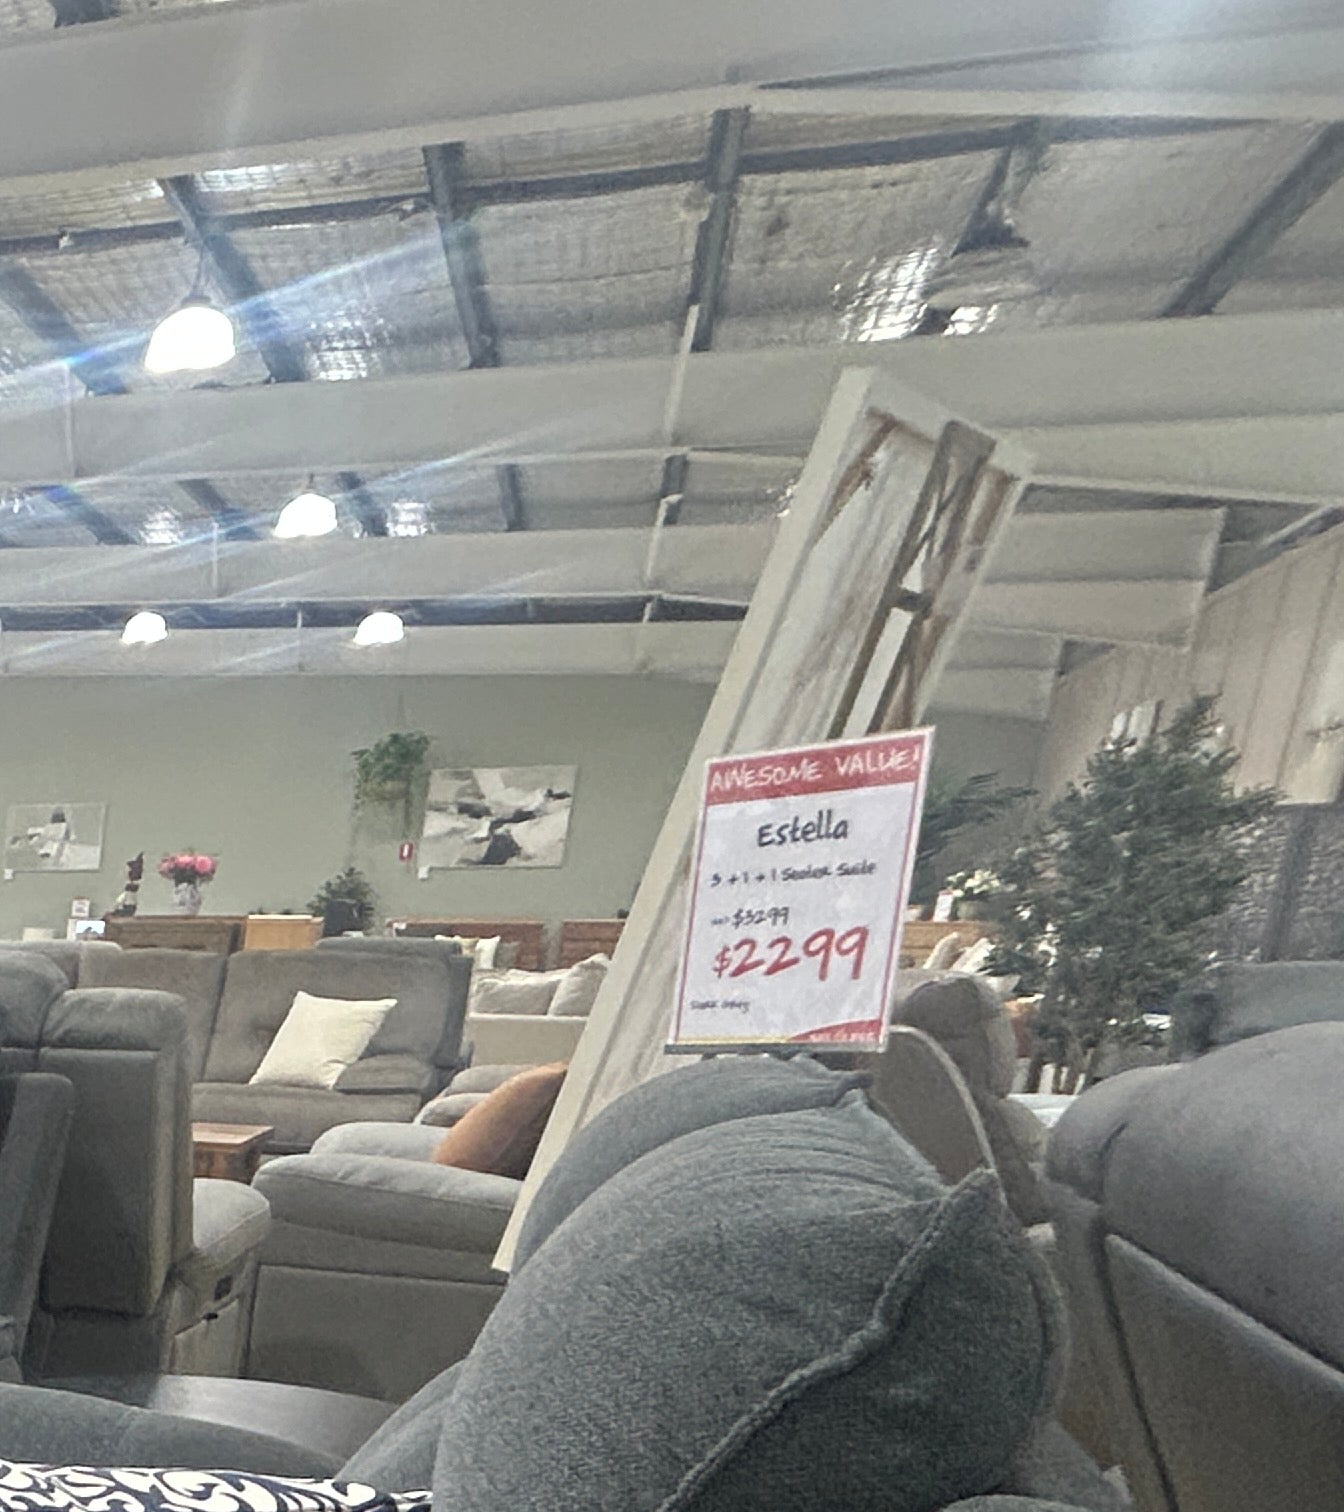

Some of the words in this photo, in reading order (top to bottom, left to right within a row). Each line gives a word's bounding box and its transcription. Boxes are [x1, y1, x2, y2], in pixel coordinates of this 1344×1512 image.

[710, 759, 824, 792] AWESOME
[835, 747, 920, 775] VALUE!
[757, 809, 849, 847] Estella
[712, 926, 870, 981] $2299
